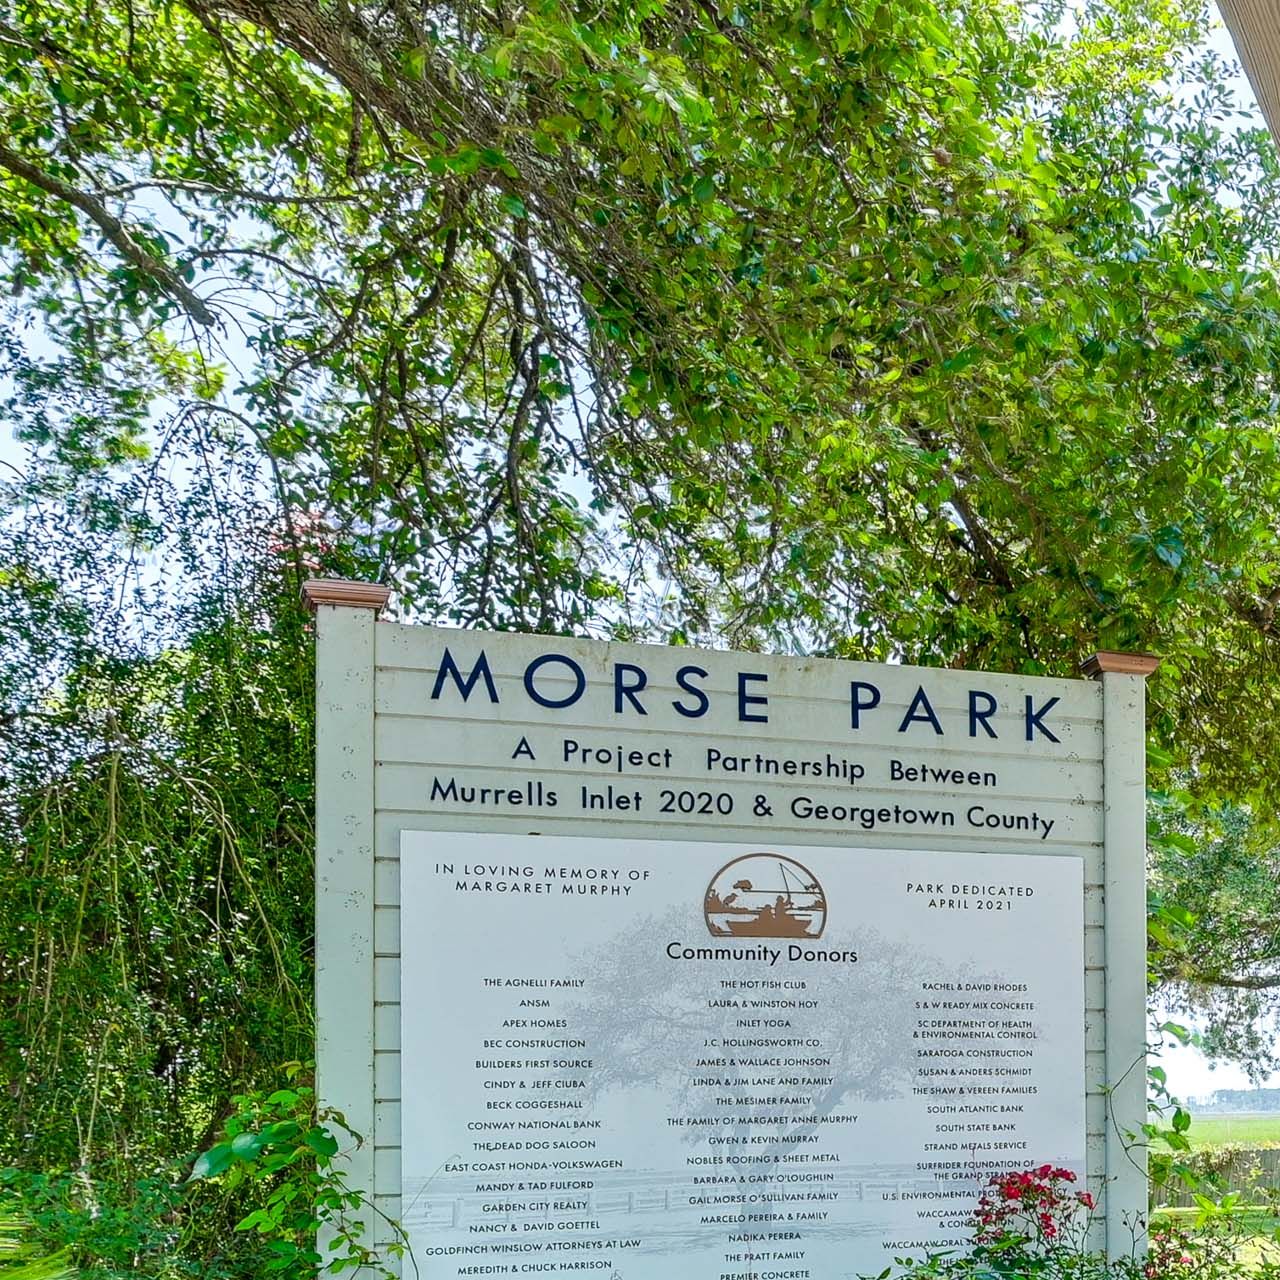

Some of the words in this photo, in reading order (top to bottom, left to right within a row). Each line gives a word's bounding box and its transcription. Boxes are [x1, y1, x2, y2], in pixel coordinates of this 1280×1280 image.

[431, 647, 769, 723] MORSE
[851, 681, 1062, 744] PARK
[512, 736, 535, 760] A
[564, 740, 672, 772] Project
[708, 749, 864, 785] Partnership
[891, 760, 996, 786] Between
[431, 777, 557, 806] Murrells
[582, 786, 641, 811] Inlet
[660, 790, 733, 815] 2020
[753, 795, 773, 816] &
[791, 796, 954, 830] Georgetown
[967, 806, 1054, 839] County
[435, 863, 454, 874] IN
[465, 865, 534, 877] LOVING
[545, 868, 618, 880] MEMORY
[628, 870, 650, 881] OF
[456, 881, 552, 893] MARGARET
[562, 884, 632, 896] MURPHY
[907, 883, 944, 893] PARK
[952, 885, 1034, 896] DEDICATED
[929, 899, 968, 909] APRIL
[977, 900, 1011, 910] 2021
[667, 942, 780, 966] Community
[789, 945, 857, 963] Donors
[505, 979, 547, 987] AGNELLI
[762, 981, 781, 989] FISH
[784, 981, 806, 989] CLUB
[957, 983, 963, 991] &
[966, 983, 991, 991] DAVID
[764, 1020, 791, 1028] YOGA
[918, 1020, 929, 1028] SC
[931, 1020, 985, 1028] DEPARTMENT
[922, 1031, 995, 1039] ENVIRONMENTAL
[997, 1031, 1037, 1039] CONTROL
[484, 1040, 502, 1048] BEC
[505, 1040, 585, 1048] CONSTRUCTION
[704, 1039, 720, 1047] J.C.
[723, 1039, 803, 1047] HOLLINGSWORTH
[806, 1039, 822, 1047] CO.
[526, 1060, 550, 1068] FIRST
[553, 1060, 593, 1068] SOURCE
[696, 1059, 726, 1067] JAMES
[739, 1058, 781, 1066] WALLACE
[783, 1058, 830, 1066] JOHNSON
[918, 1068, 948, 1076] SUSAN
[951, 1068, 956, 1076] &
[995, 1068, 1032, 1076] SCHMIDT
[484, 1081, 515, 1089] CINDY
[531, 1081, 552, 1089] JEFF
[555, 1080, 585, 1088] CIUBA
[693, 1078, 721, 1086] LINDA
[725, 1078, 731, 1086] &
[734, 1078, 749, 1086] JIM
[802, 1077, 833, 1085] FAMILY
[1002, 1086, 1037, 1094] FAMILIES
[487, 1101, 512, 1109] BECK
[515, 1101, 583, 1109] COGGESHALL
[736, 1097, 777, 1105] MESIMER
[780, 1097, 811, 1105] FAMILY
[959, 1105, 998, 1113] ATLANTIC
[467, 1121, 515, 1130] CONWAY
[518, 1121, 571, 1129] NATIONAL
[668, 1118, 684, 1126] THE
[687, 1118, 719, 1126] FAMILY
[722, 1117, 735, 1125] OF
[738, 1117, 788, 1125] MARGARET
[791, 1116, 818, 1124] ANNE
[820, 1115, 858, 1123] MURPHY
[936, 1124, 964, 1132] SOUTH
[709, 1137, 739, 1145] GWEN
[751, 1136, 779, 1144] KEVIN
[782, 1135, 819, 1144] MURRAY
[687, 1156, 723, 1165] NOBLES
[726, 1156, 771, 1164] ROOFING
[774, 1155, 780, 1163] &
[783, 1153, 809, 1162] SHEET
[812, 1154, 840, 1162] METAL
[445, 1164, 468, 1172] EAST
[472, 1163, 505, 1171] COAST
[509, 1160, 623, 1170] HONDA-VOLKSWAGEN
[917, 1162, 961, 1170] SURFRIDER
[964, 1161, 1021, 1171] FOUNDATION
[1023, 1160, 1035, 1170] OF
[694, 1176, 736, 1184] BARBARA
[748, 1175, 773, 1183] GARY
[777, 1173, 834, 1182] O'LOUGHLIN
[476, 1183, 514, 1192] MANDY
[518, 1183, 525, 1191] &
[528, 1182, 547, 1190] TAD
[550, 1181, 593, 1190] FULFORD
[483, 1201, 525, 1212] GARDEN
[529, 1202, 550, 1211] CITY
[554, 1201, 588, 1210] REALTY
[700, 1215, 746, 1224] MARCELO
[748, 1214, 784, 1222] PEREIRA
[797, 1212, 828, 1220] FAMILY
[470, 1224, 507, 1233] NANCY
[511, 1224, 517, 1232] &
[524, 1223, 554, 1231] DAVID
[558, 1221, 600, 1230] GOETTEL
[729, 1232, 765, 1242] NADIKA
[768, 1232, 801, 1241] PERERA
[426, 1245, 487, 1256] GOLDFINCH
[491, 1243, 542, 1253] WINSLOW
[546, 1241, 602, 1251] ATTORNEYS
[606, 1241, 617, 1249] AT
[620, 1240, 641, 1248] LAW
[458, 1265, 508, 1275] MEREDITH
[522, 1263, 556, 1272] CHUCK
[560, 1261, 612, 1271] HARRISON
[762, 1271, 810, 1280] CONCRETE
